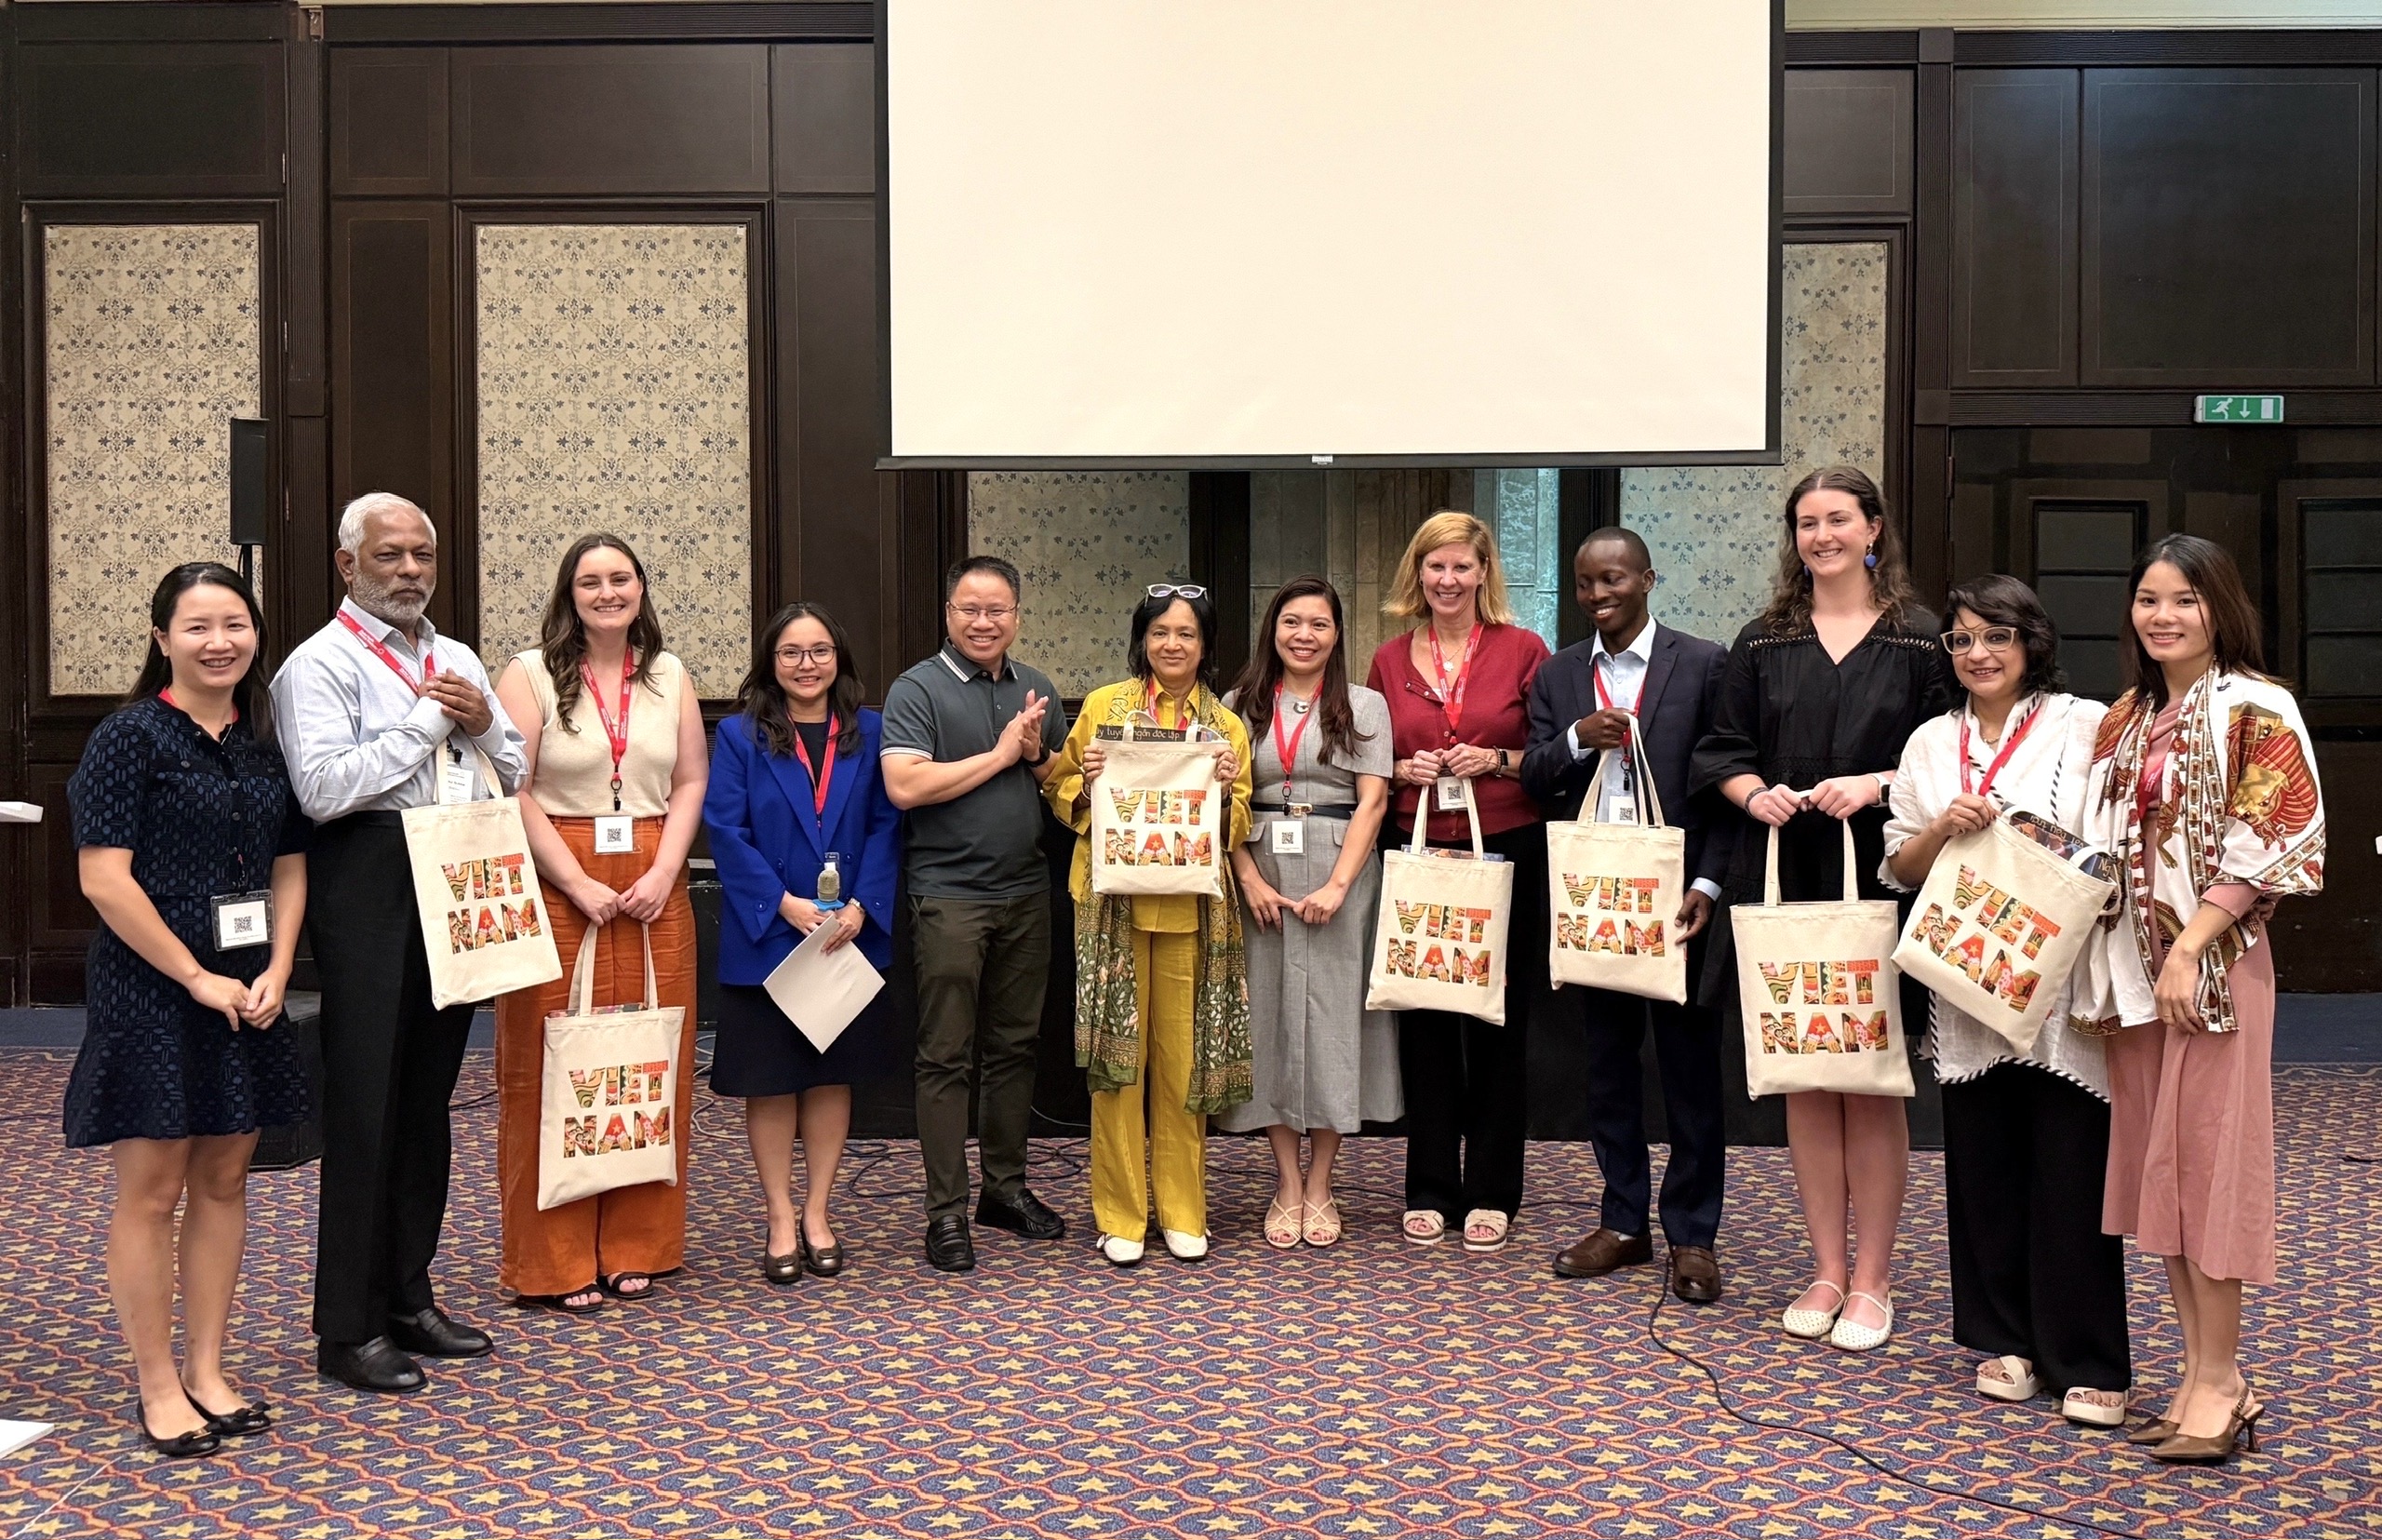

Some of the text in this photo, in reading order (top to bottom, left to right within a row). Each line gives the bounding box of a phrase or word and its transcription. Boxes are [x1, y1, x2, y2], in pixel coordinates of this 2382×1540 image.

[1109, 786, 1208, 825] VIET
[1104, 828, 1212, 866] NAM
[440, 852, 525, 903] VIET
[1562, 872, 1660, 915] VIET
[448, 898, 542, 955] NAM
[1395, 899, 1492, 944] VIET
[1557, 911, 1666, 957] NAM
[1953, 863, 2062, 961] VIET
[1385, 937, 1492, 987] NAM
[1910, 902, 2042, 1013] NAM
[1757, 958, 1880, 1005] VIET
[1760, 1010, 1889, 1055] NAM
[568, 1060, 669, 1108] VIET
[564, 1105, 671, 1158] NAM
